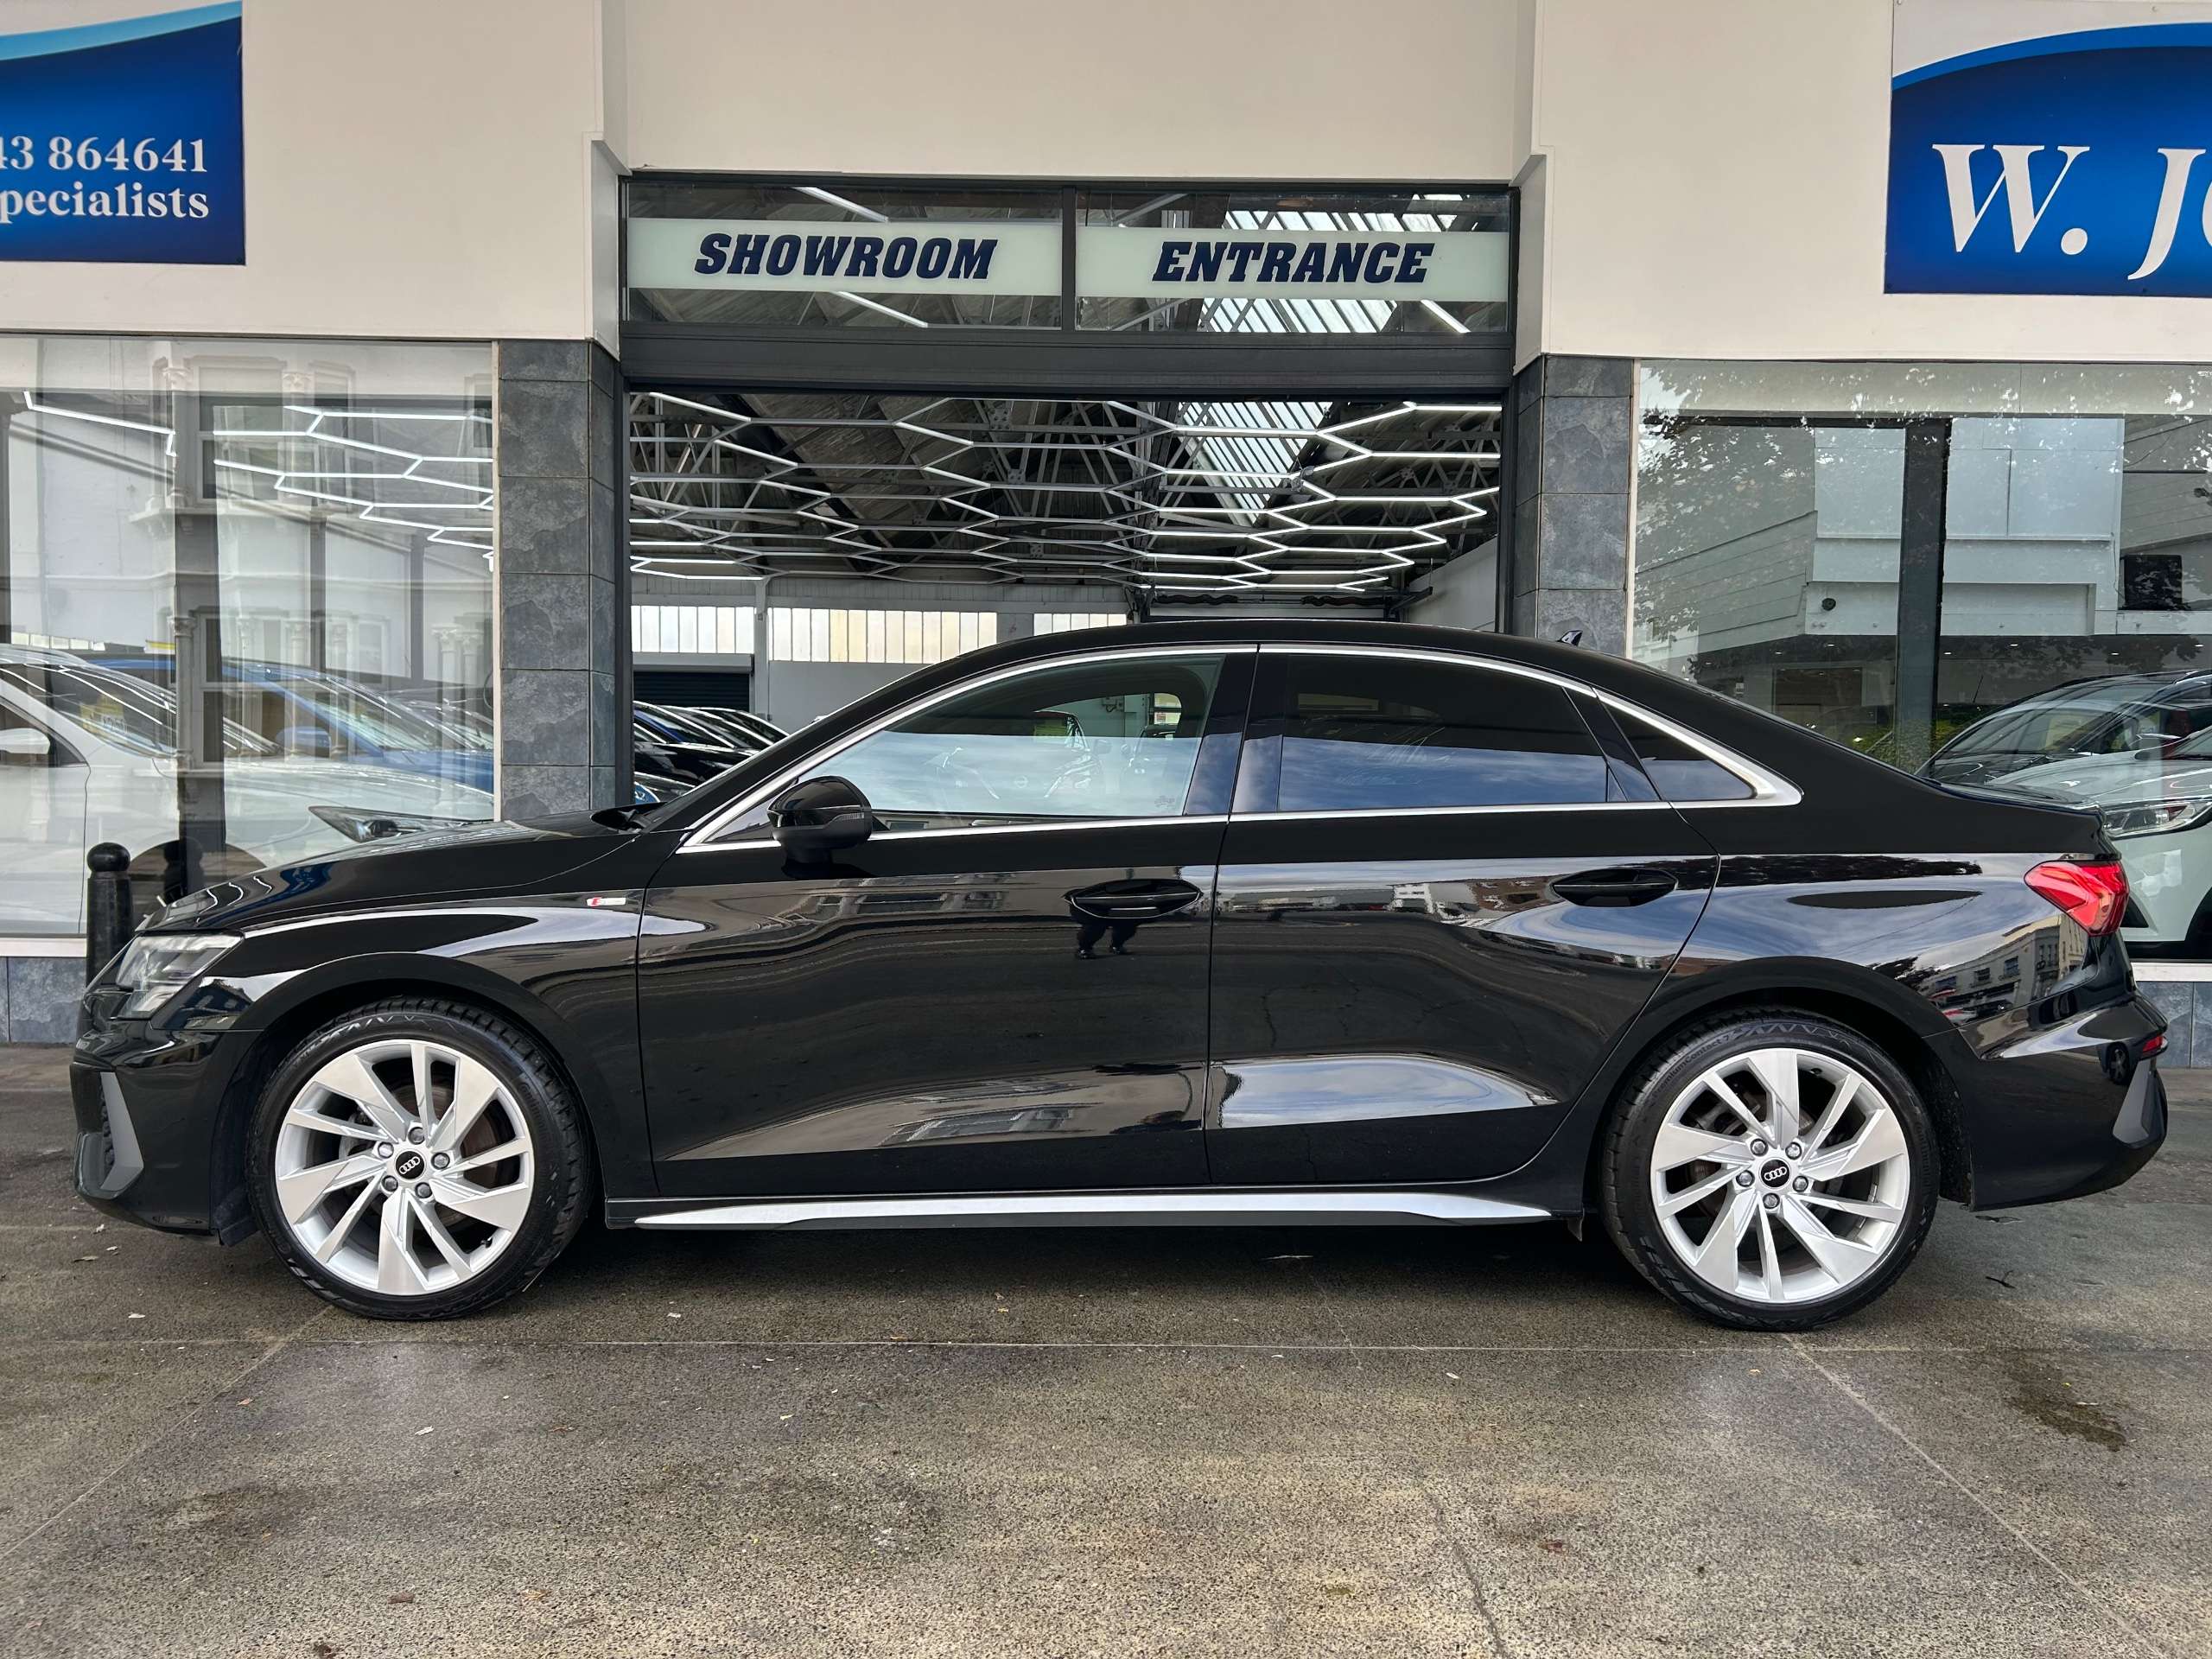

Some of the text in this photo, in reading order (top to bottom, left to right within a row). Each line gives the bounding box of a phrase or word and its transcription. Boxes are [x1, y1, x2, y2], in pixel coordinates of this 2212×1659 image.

[48, 137, 208, 173] 864641
[0, 181, 210, 225] pecialists
[1932, 143, 2212, 281] W. J
[694, 232, 1435, 283] SHOWROOM ENTRANCE
